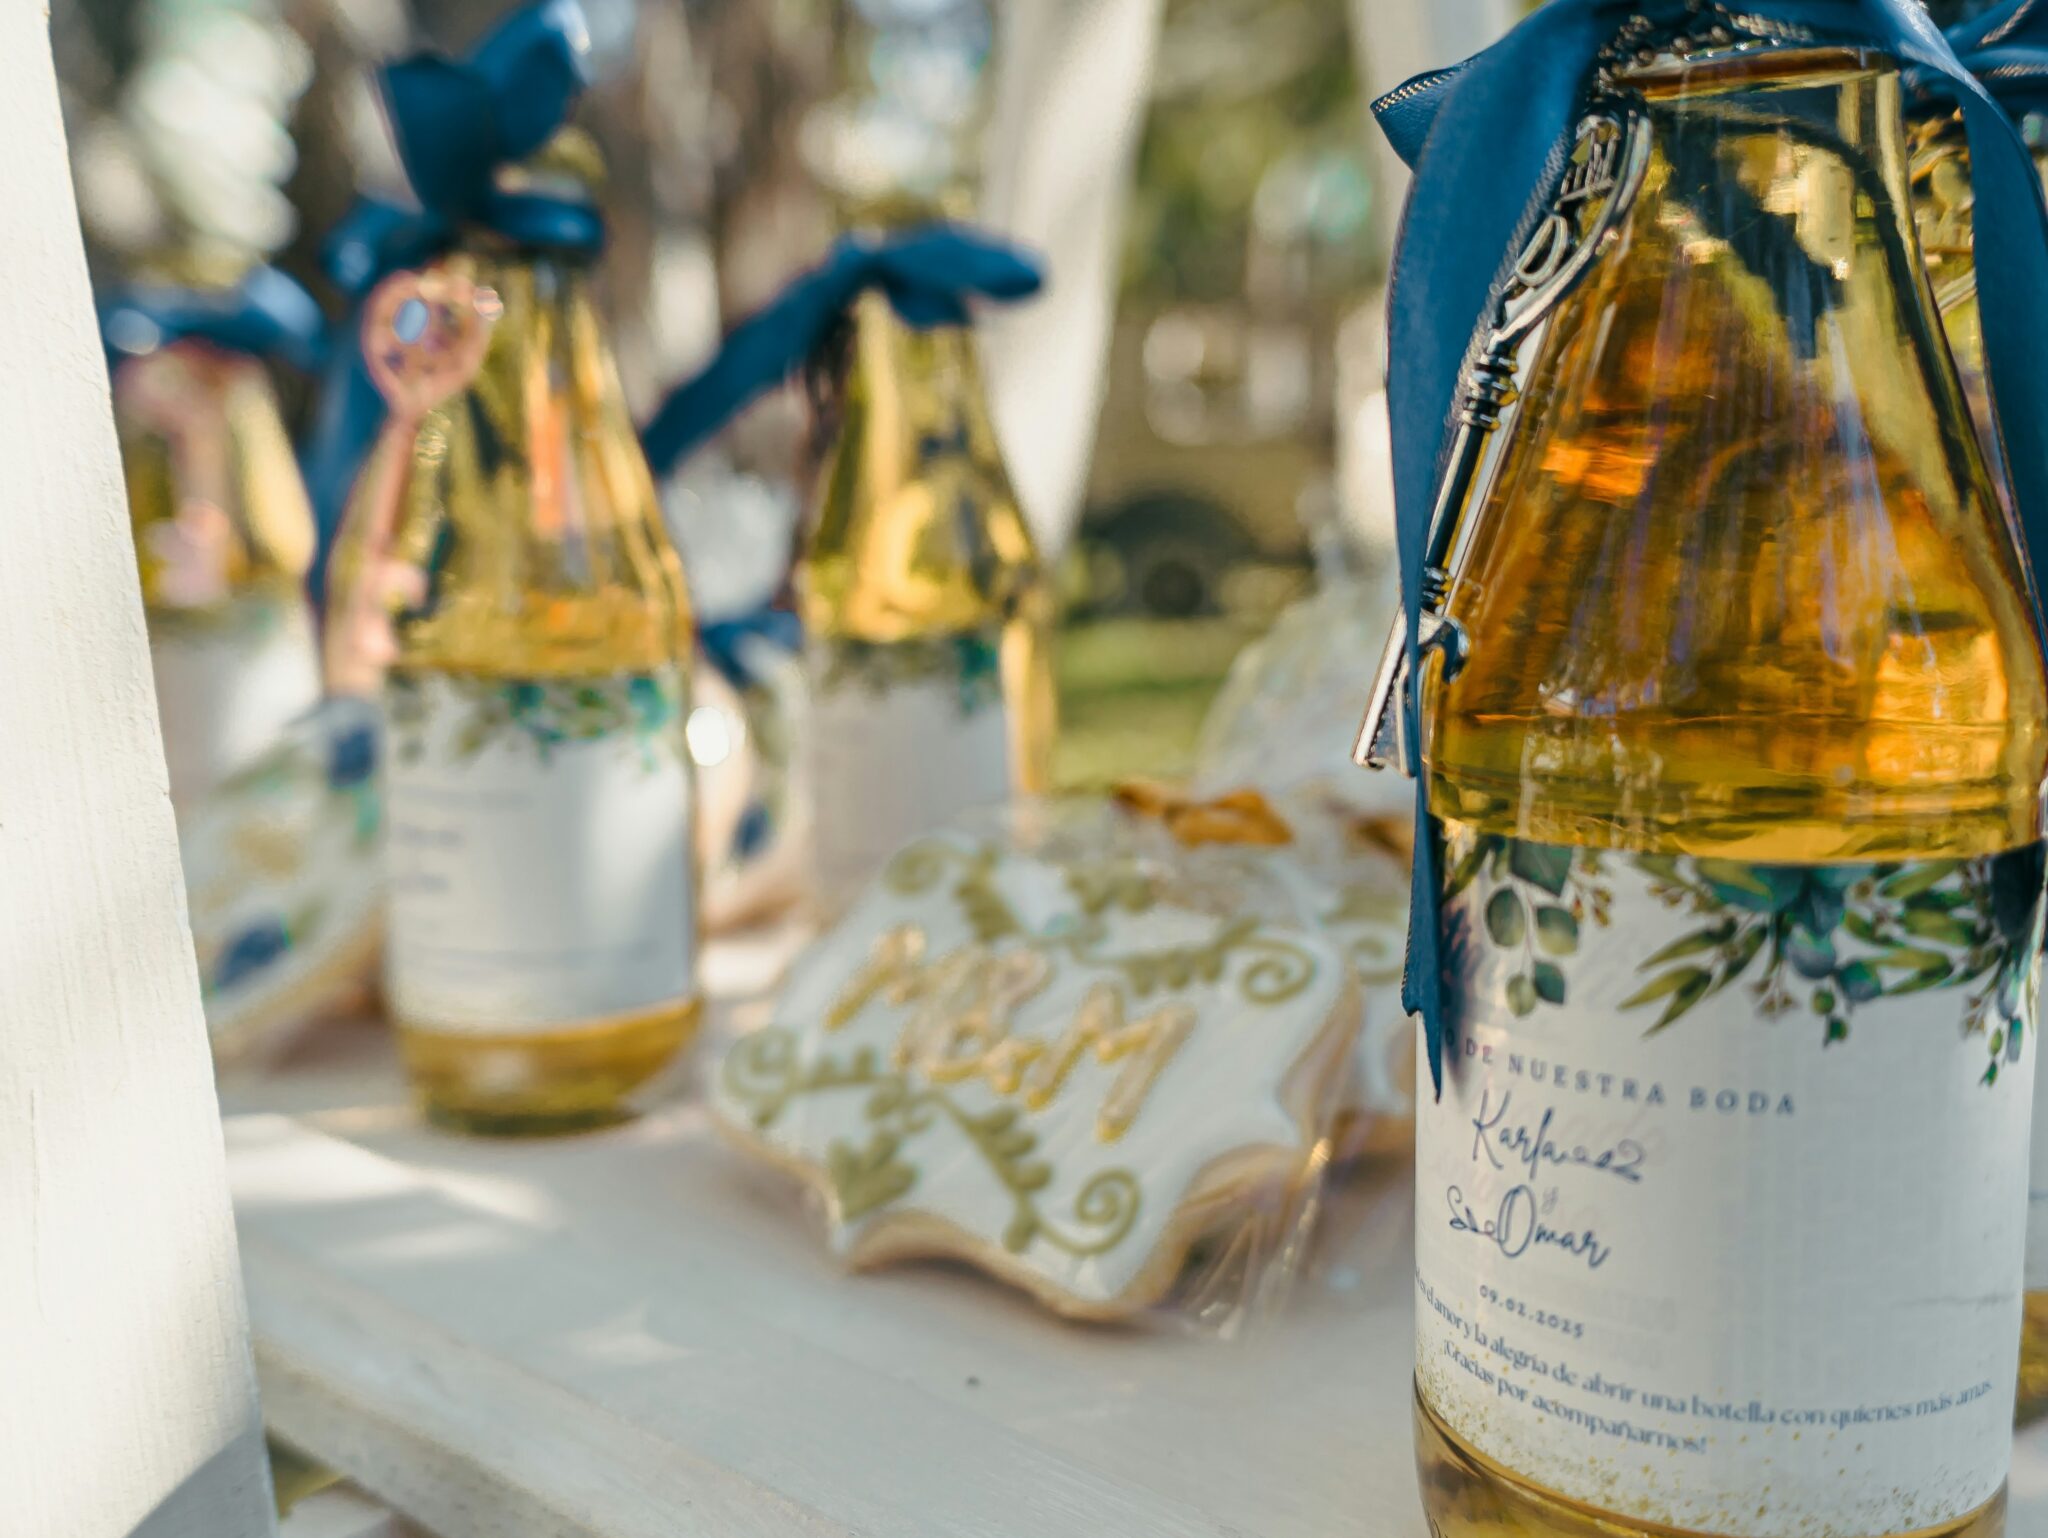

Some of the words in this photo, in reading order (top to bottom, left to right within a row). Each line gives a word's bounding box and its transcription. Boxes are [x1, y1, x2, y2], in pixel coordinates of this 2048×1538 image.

[1465, 1037, 1493, 1065] DE
[1508, 1053, 1666, 1106] NUESTRA
[1688, 1085, 1797, 1117] BODA
[1479, 1284, 1585, 1339] 09.02.2025
[1434, 1297, 1463, 1330] amor
[1474, 1322, 1488, 1347] la
[1552, 1361, 1578, 1387] de
[1581, 1372, 1635, 1405] abrir
[1641, 1392, 1687, 1415] una
[1692, 1394, 1776, 1424] botella
[1780, 1407, 1826, 1426] con
[1830, 1403, 1913, 1431] quienes
[1915, 1392, 1953, 1416] más
[1498, 1377, 1528, 1402] por
